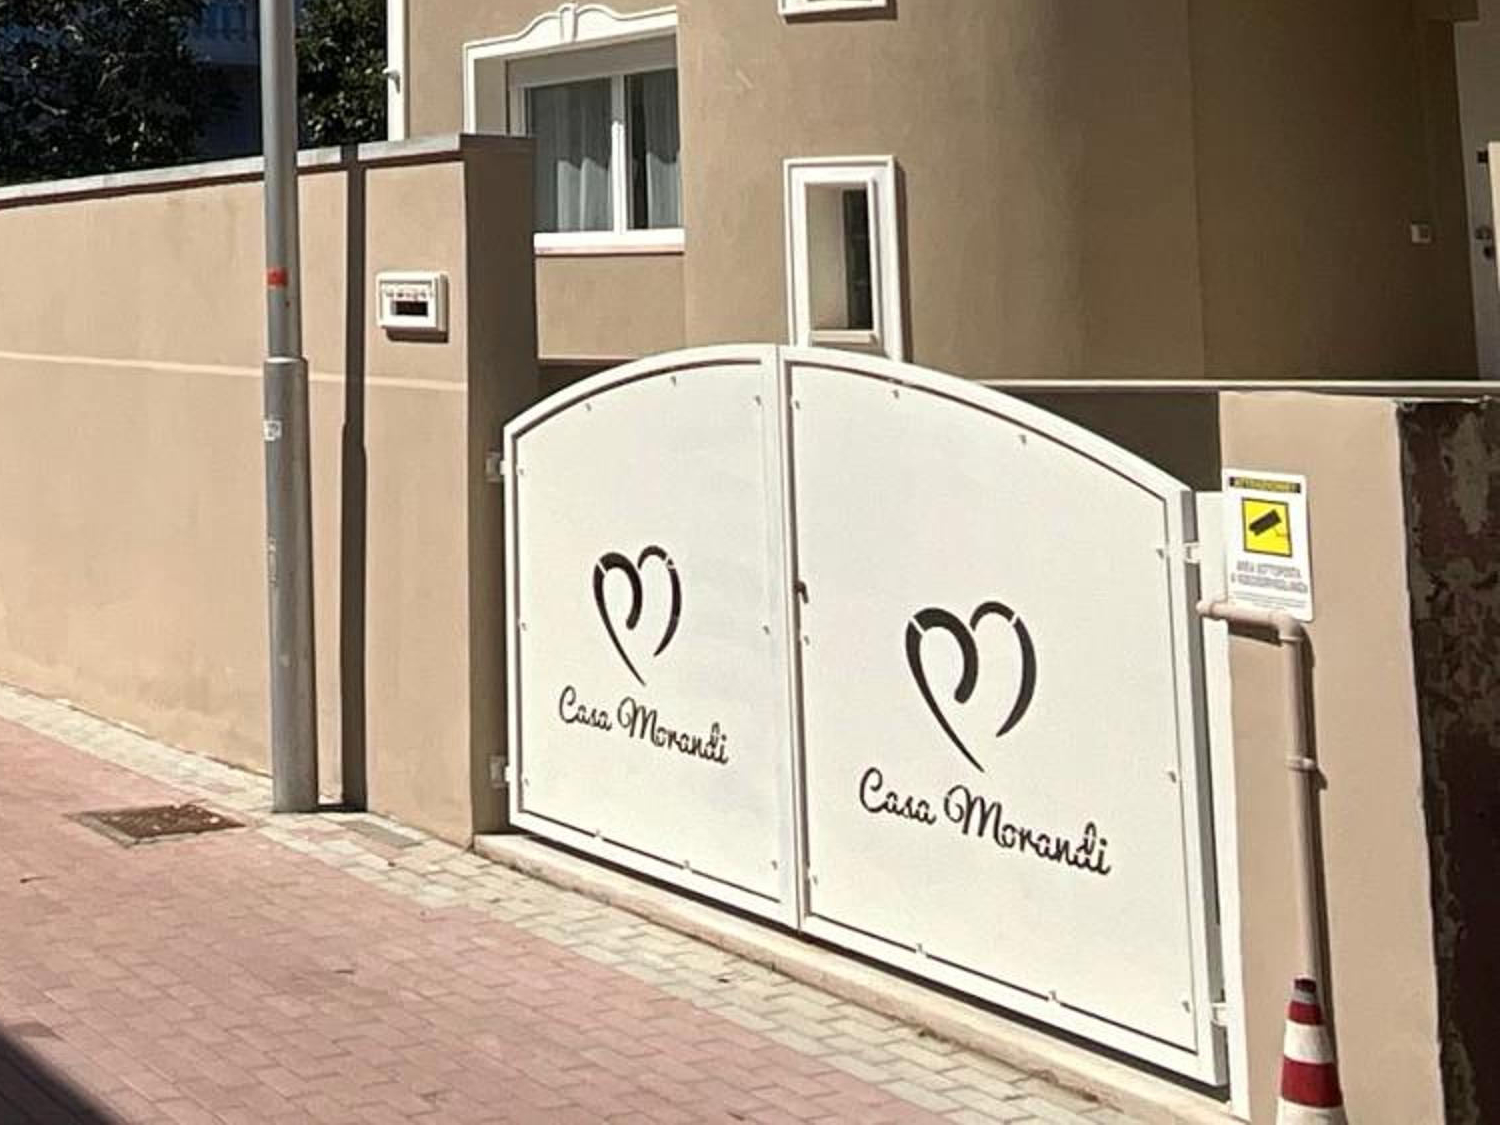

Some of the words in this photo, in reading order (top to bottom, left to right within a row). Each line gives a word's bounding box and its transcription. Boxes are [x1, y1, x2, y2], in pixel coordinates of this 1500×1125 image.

[558, 685, 613, 732] Casa
[617, 695, 729, 765] Morandi
[858, 766, 937, 826] Casa
[943, 783, 1112, 876] Morandi
